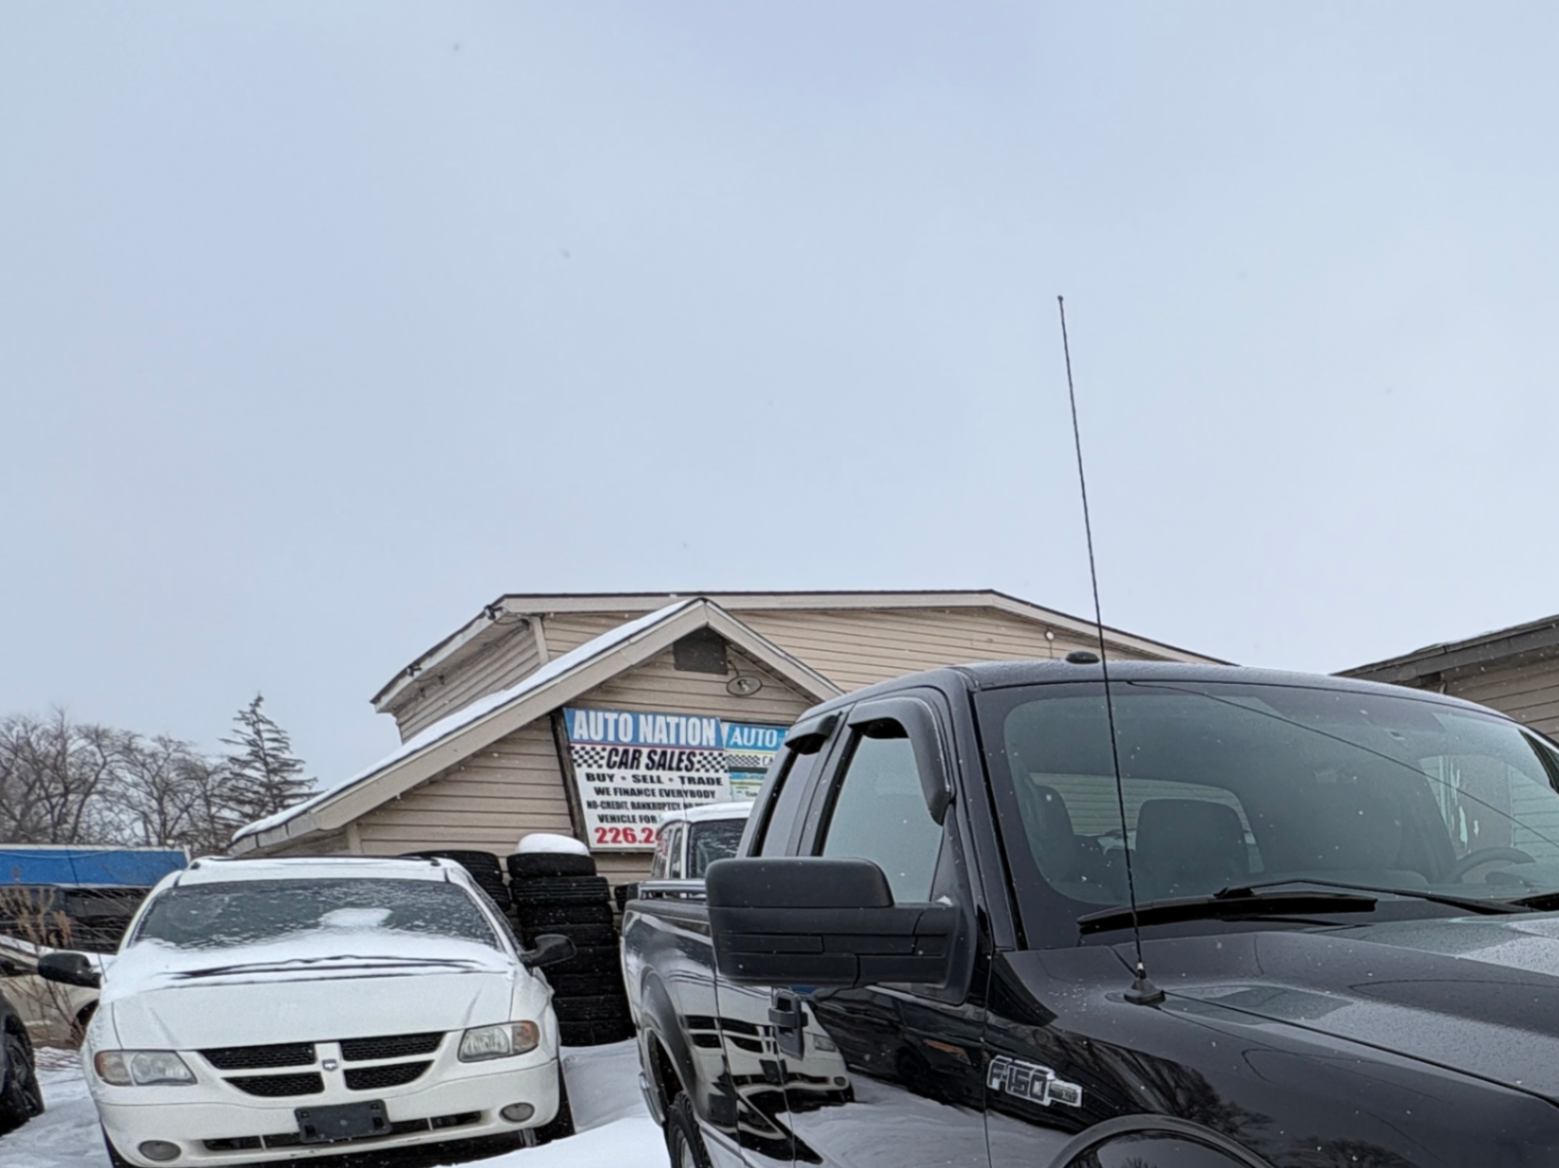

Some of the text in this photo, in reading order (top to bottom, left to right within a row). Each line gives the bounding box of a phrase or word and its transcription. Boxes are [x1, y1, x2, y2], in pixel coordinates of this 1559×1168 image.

[573, 710, 716, 747] AUTO NATION
[729, 727, 778, 748] AUTO
[606, 747, 697, 772] CAR SALES
[586, 773, 723, 787] BUY SELL TRADE
[594, 787, 716, 799] WE FINANCE EVERYBODY
[598, 814, 658, 824] VEHICLE FOR
